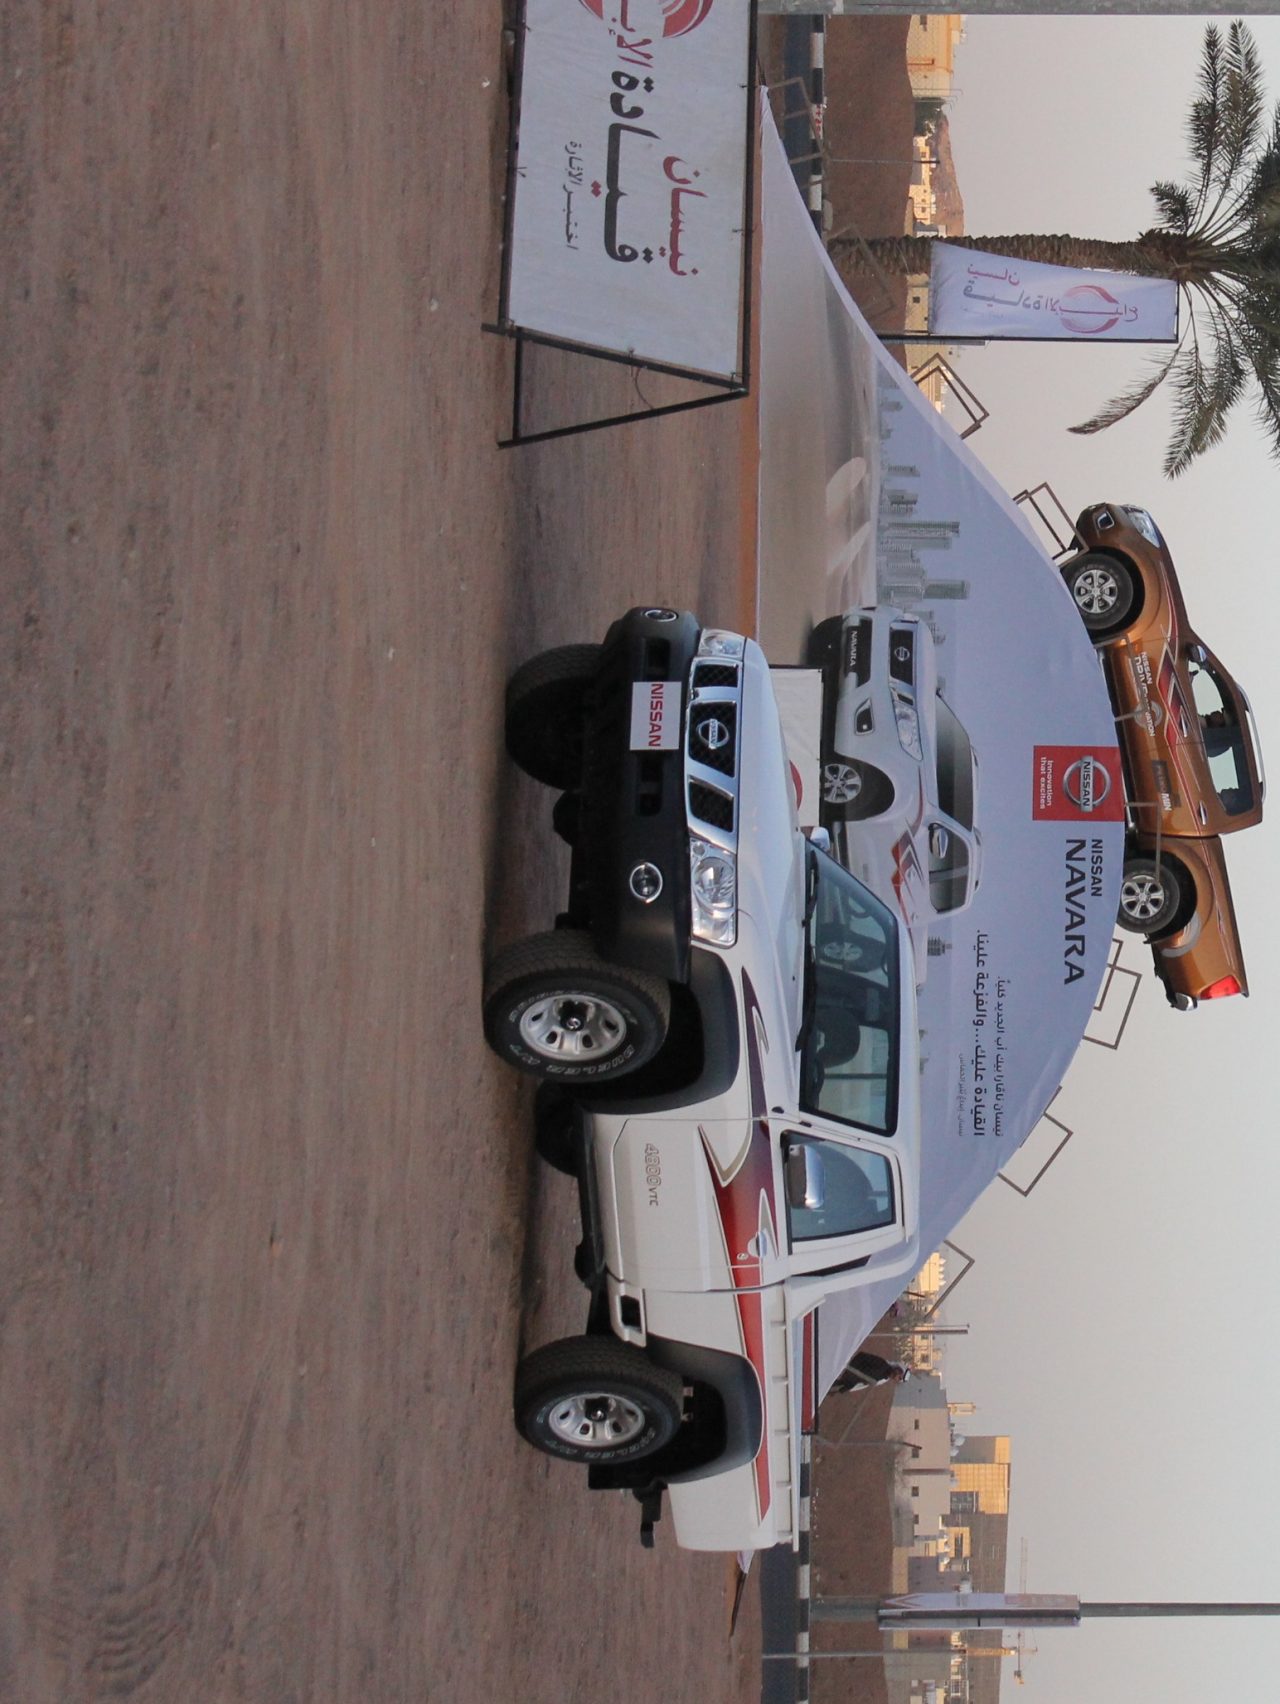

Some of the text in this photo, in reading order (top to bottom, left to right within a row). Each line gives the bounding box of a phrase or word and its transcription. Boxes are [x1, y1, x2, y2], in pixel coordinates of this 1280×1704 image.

[590, 70, 661, 265] قيادة
[562, 183, 580, 251] اختبر
[658, 156, 709, 276] نيسان
[648, 683, 664, 747] NISSAN
[1039, 756, 1047, 810] that excites
[1046, 760, 1054, 806] Innovation
[1082, 761, 1091, 807] NISSAN
[1090, 839, 1103, 897] NISSAN
[1063, 839, 1087, 986] NAVARA
[993, 1000, 1006, 1034] الجديد
[970, 1087, 988, 1136] القيادة
[992, 1103, 1005, 1137] نيسان
